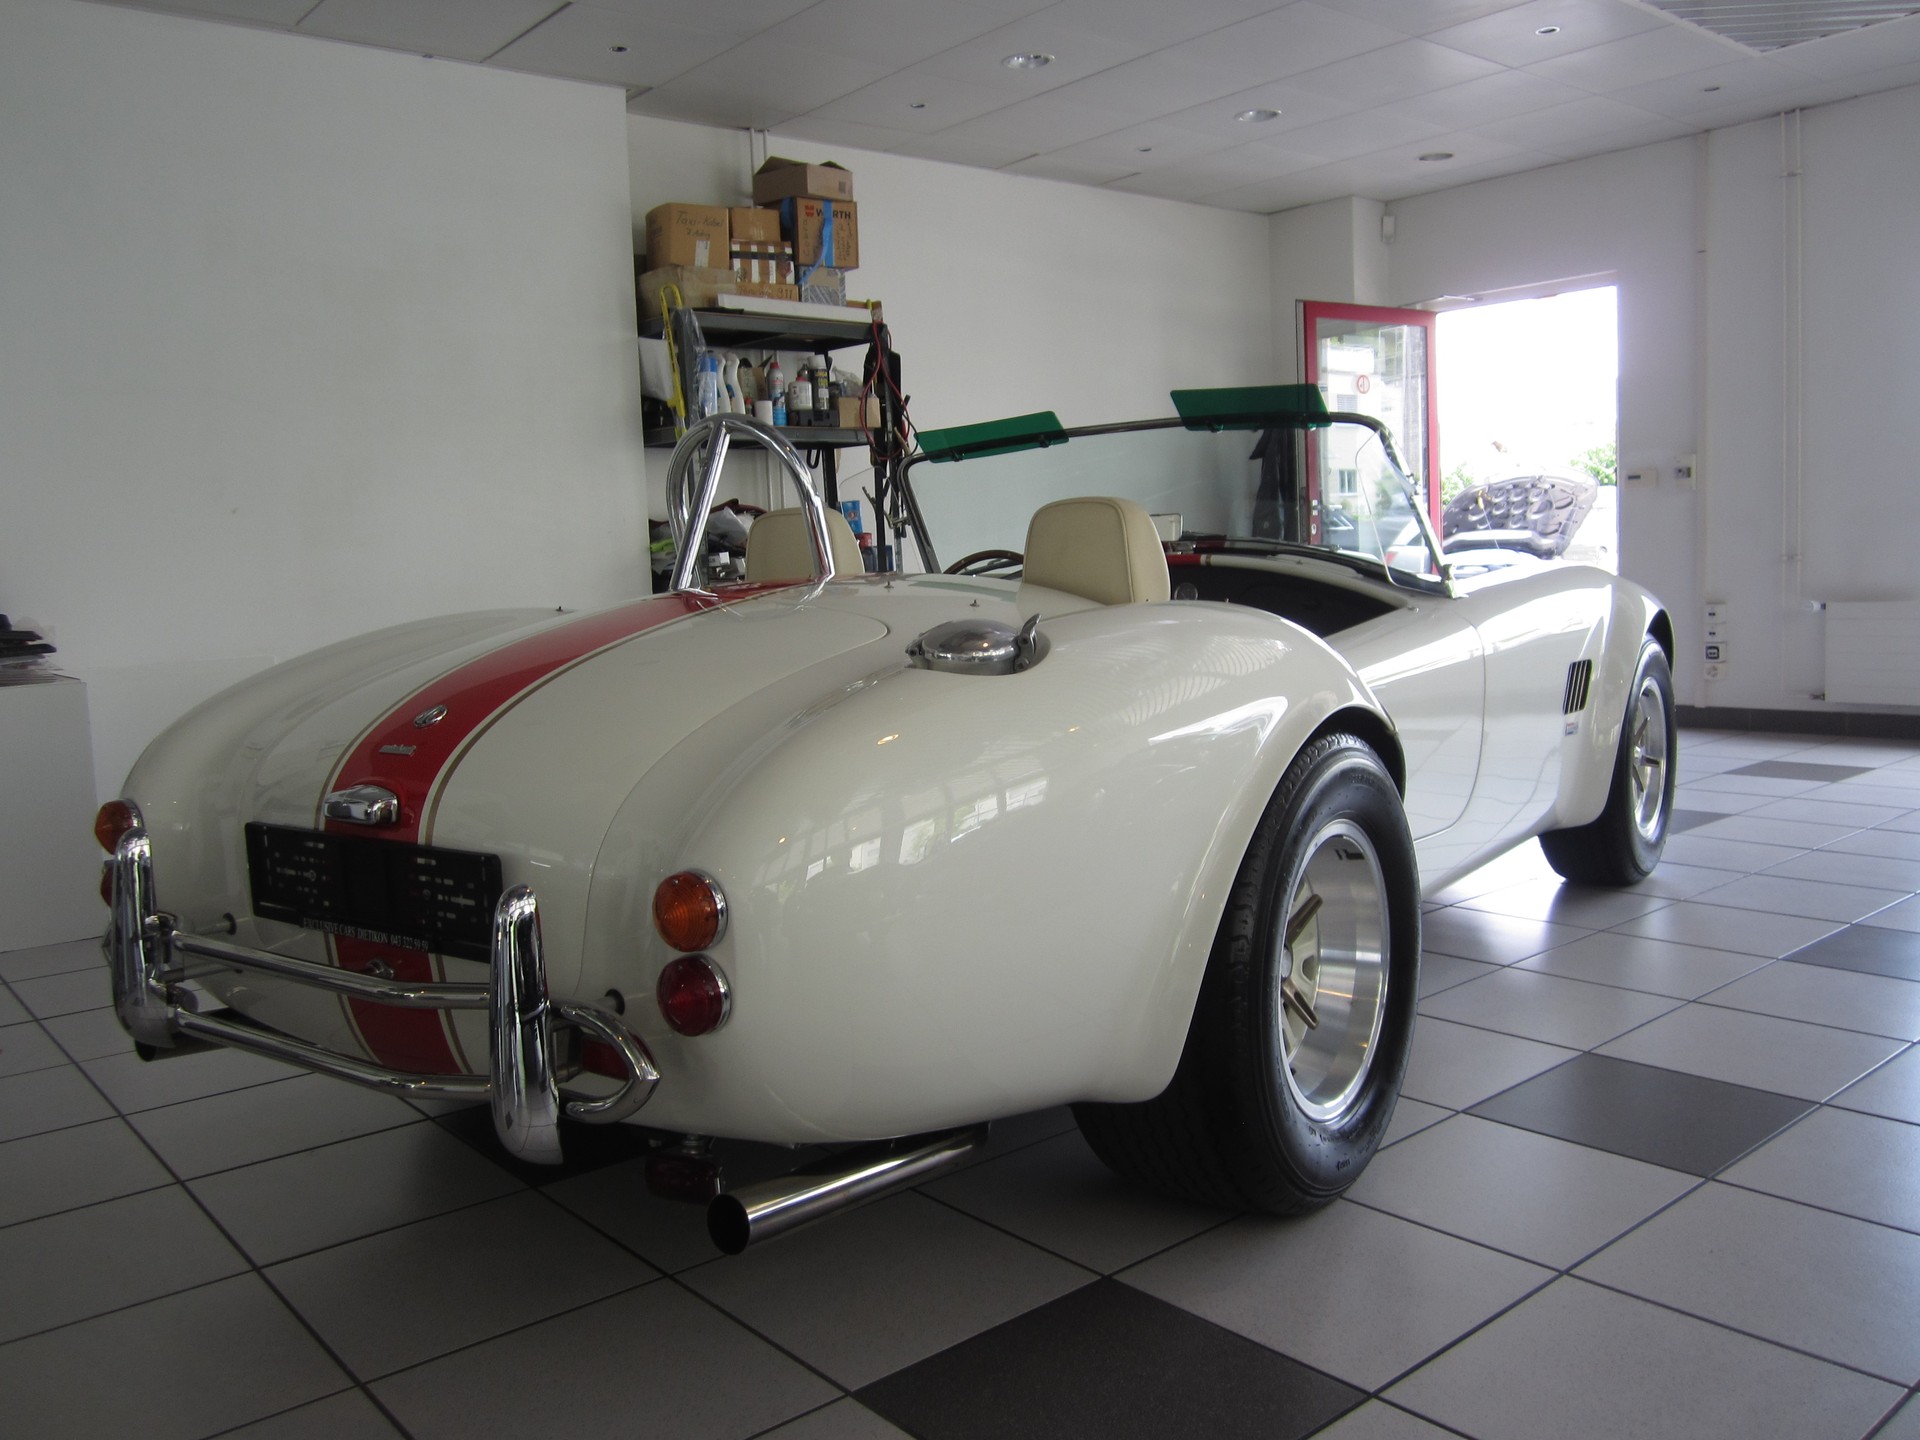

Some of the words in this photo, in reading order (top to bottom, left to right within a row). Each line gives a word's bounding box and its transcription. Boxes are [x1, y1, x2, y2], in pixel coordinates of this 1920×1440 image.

[816, 208, 851, 219] WRTH
[303, 917, 339, 934] EXCLUSIVE
[339, 924, 355, 938] CARS
[357, 927, 388, 944] DIETIKON
